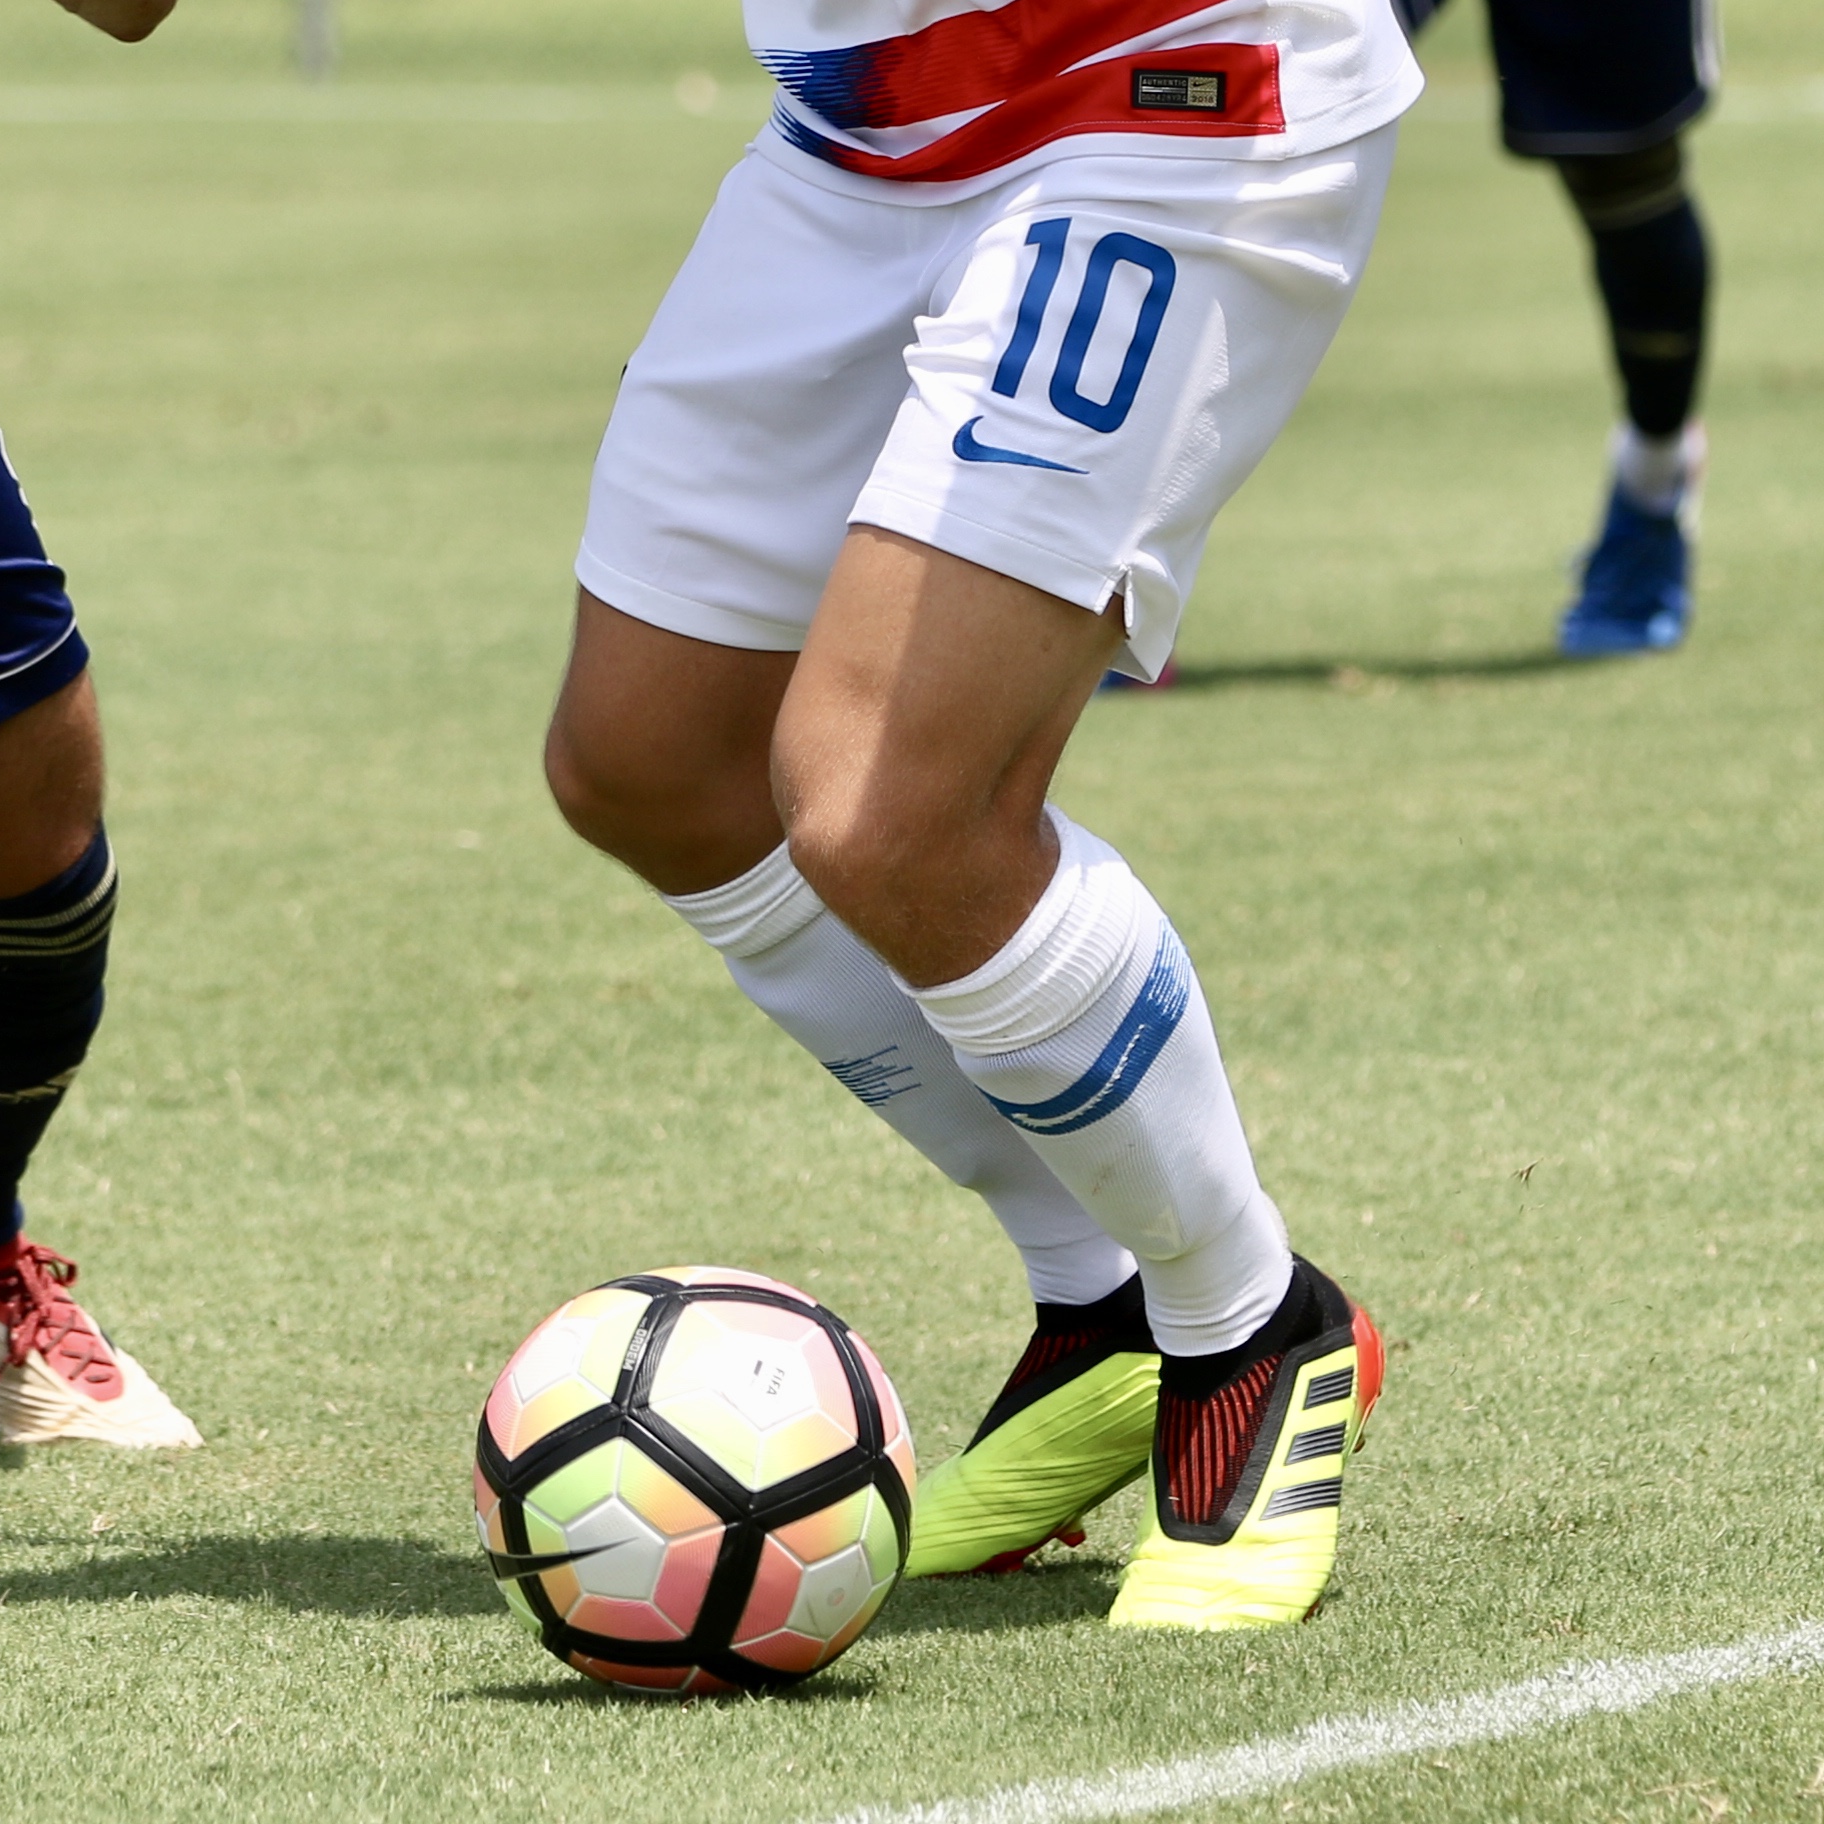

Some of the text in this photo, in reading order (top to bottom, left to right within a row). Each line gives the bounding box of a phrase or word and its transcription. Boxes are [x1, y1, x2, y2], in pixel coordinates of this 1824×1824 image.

[1142, 78, 1187, 87] AUTHENTIC
[991, 216, 1177, 434] 10
[623, 1328, 648, 1372] ORDEM
[766, 1367, 785, 1395] FIFA
